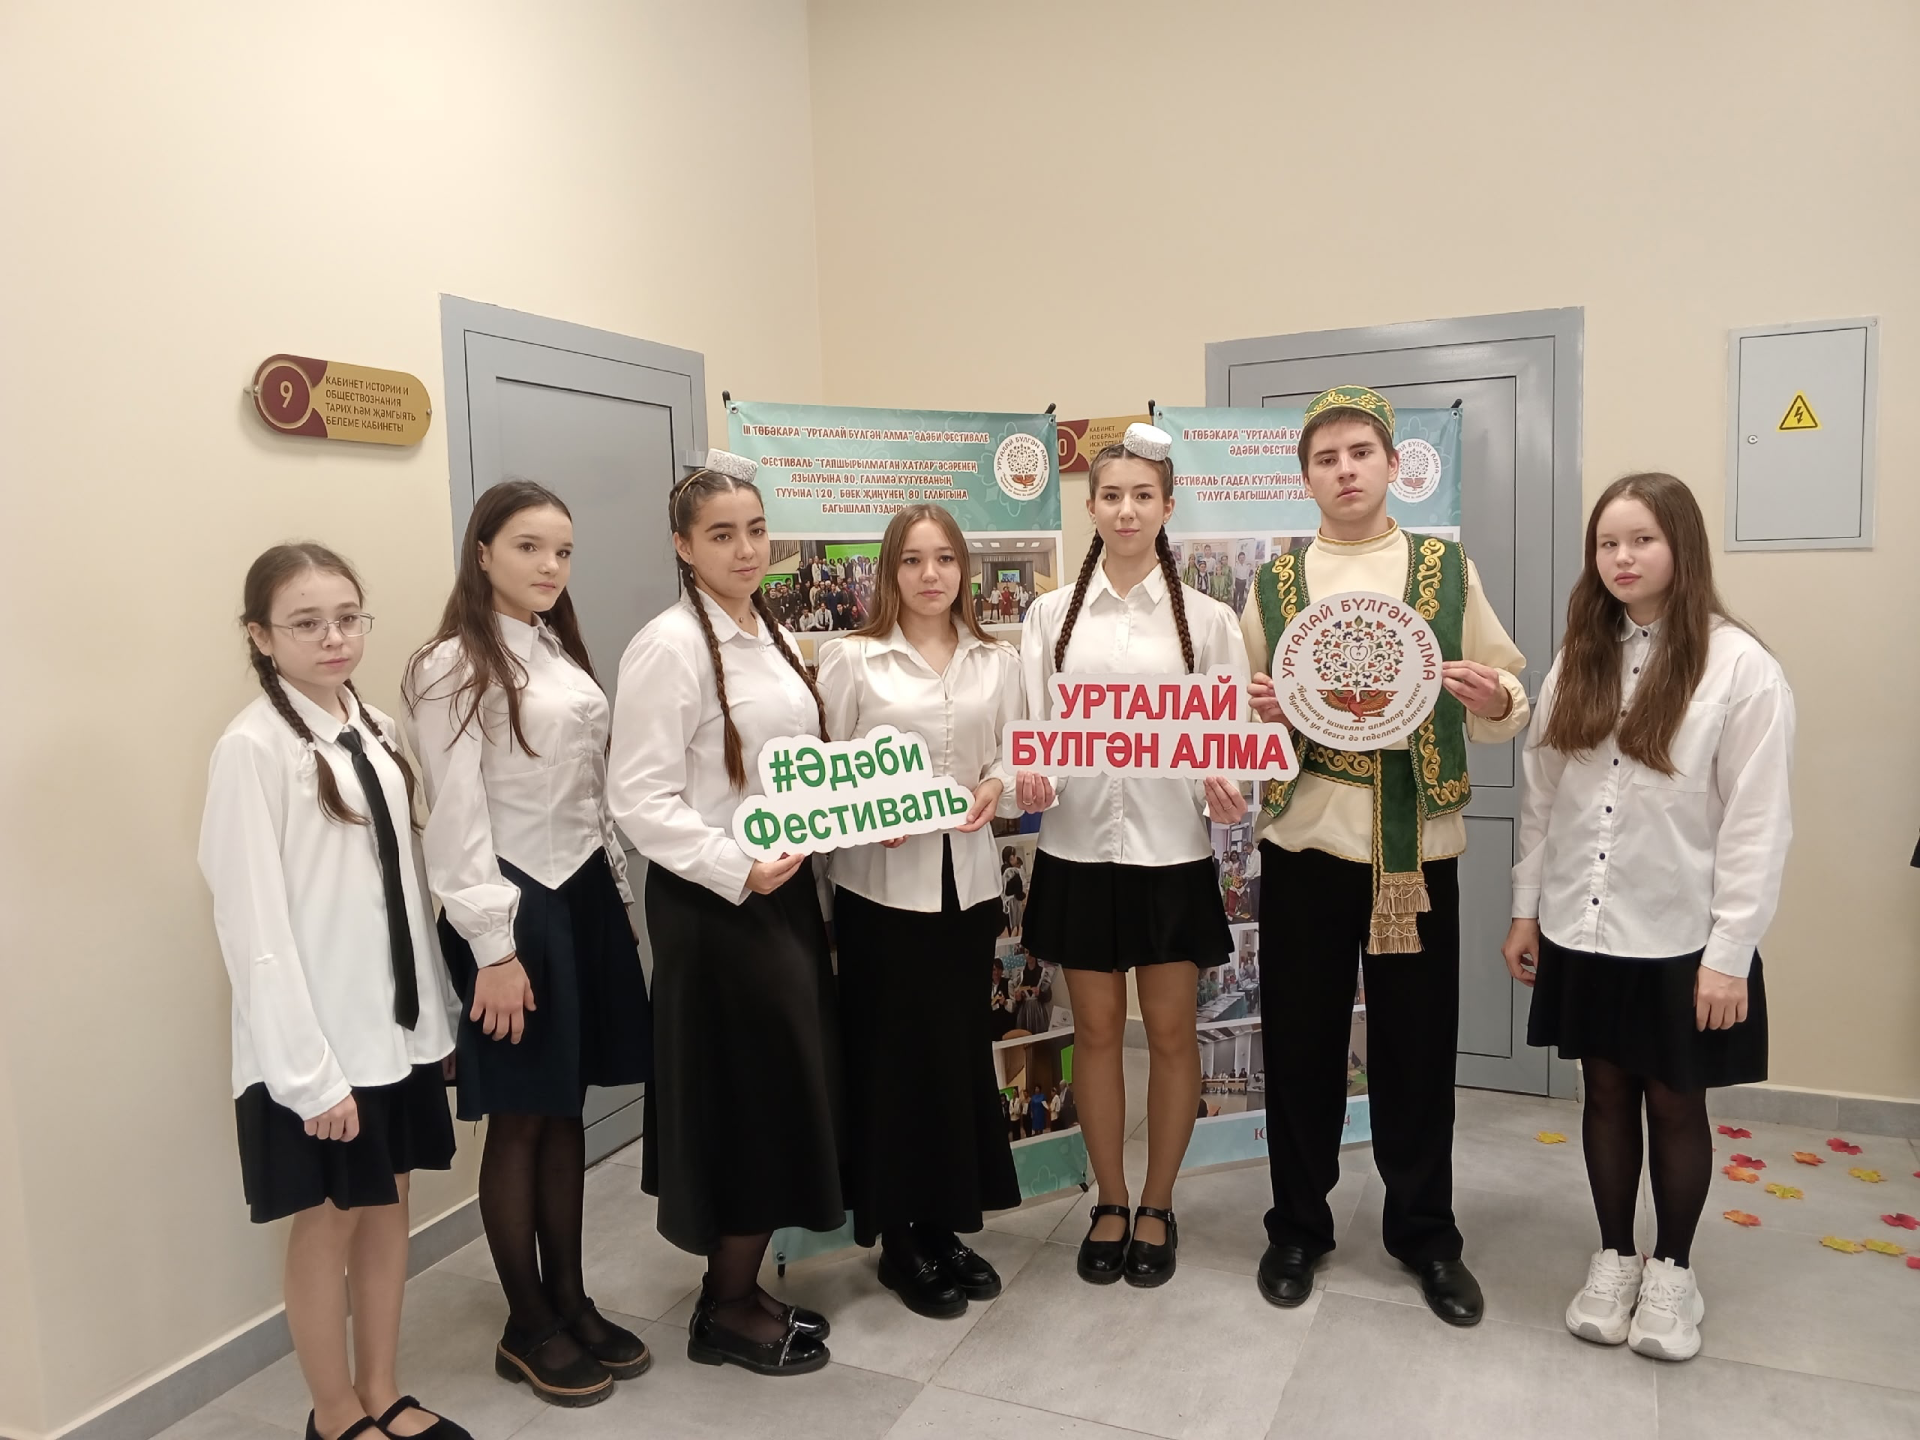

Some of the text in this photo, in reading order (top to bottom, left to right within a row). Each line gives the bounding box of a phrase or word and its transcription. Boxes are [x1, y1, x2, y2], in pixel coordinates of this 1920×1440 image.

[325, 376, 409, 395] КАБИНЕТ ИСТОРИИ И
[280, 381, 293, 408] 9
[325, 389, 401, 407] ОБЩЕСТВОЗНАНИЯ
[325, 402, 352, 414] ТАРИХ
[326, 416, 404, 432] БЕЛЕМЕ КАБИНЕТЫ
[753, 426, 800, 437] ТӨБӘКАРА
[849, 429, 881, 440] БҮЛГӘН
[915, 432, 942, 442] ӘДӘБИ
[944, 433, 989, 443] ФЕСТИВАЛЕ
[1192, 430, 1239, 440] ТӨБӘКАРА
[1230, 445, 1298, 455] ӘДӘБИ ФЕСТИВ
[761, 457, 813, 468] ФЕСТИВАЛЬ
[791, 473, 841, 484] ЯЗЫЛУЫНА
[860, 474, 898, 485] ГАЛИМӘ
[898, 476, 952, 486] КУТУЕВАНЫҢ
[1173, 473, 1301, 486] ЕСТИВАЛЬ ГАДЕЛ КУТУЙНЫҢ
[775, 488, 812, 498] ТУУЫНА
[840, 490, 861, 499] БӨЕК
[908, 490, 920, 499] 80
[924, 490, 968, 500] ЕЛЛЫГЫНА
[1197, 491, 1230, 501] ТУЛУГА
[1234, 490, 1284, 501] БАГЫШЛАП
[822, 504, 871, 514] БАГЫШЛАП
[1282, 598, 1436, 681] УРТАЛАЙ БҮЛГӘН АЛМА
[1057, 675, 1237, 721] УРТАЛАЙ
[1012, 731, 1288, 770] БҮЛГӘН АЛМА
[769, 736, 924, 793] #Әдәби
[744, 787, 968, 850] Фестиваль
